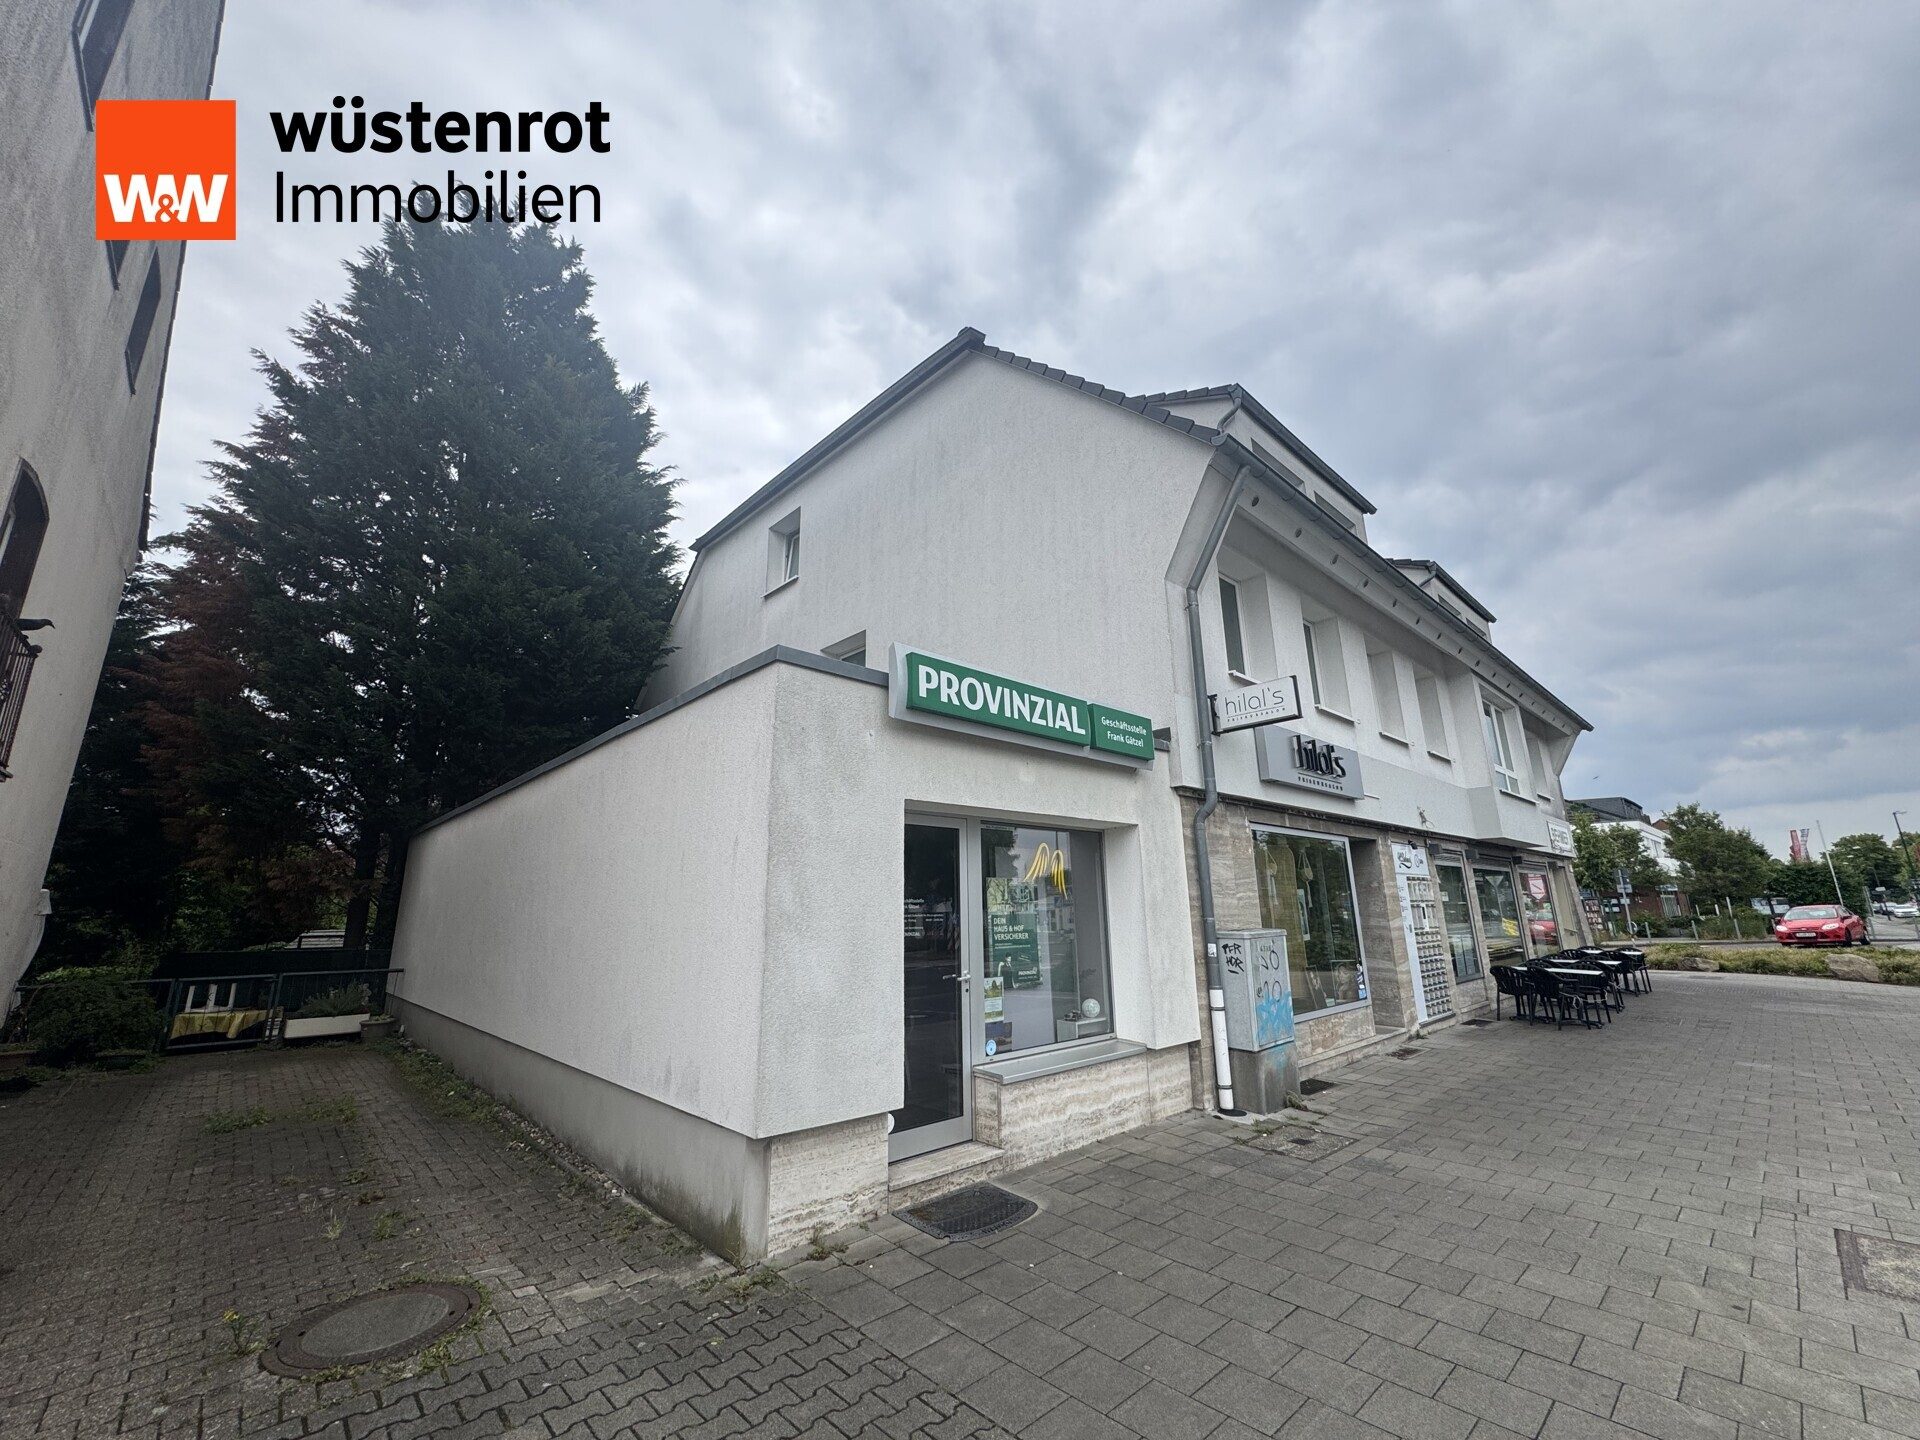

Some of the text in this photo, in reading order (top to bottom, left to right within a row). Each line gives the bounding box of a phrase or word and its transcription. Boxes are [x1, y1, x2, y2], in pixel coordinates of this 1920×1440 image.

[918, 664, 1086, 735] PROVINZIAL
[1225, 687, 1284, 715] hilal's
[1101, 716, 1147, 736] Geschäftsstelle
[1107, 730, 1125, 743] Frank
